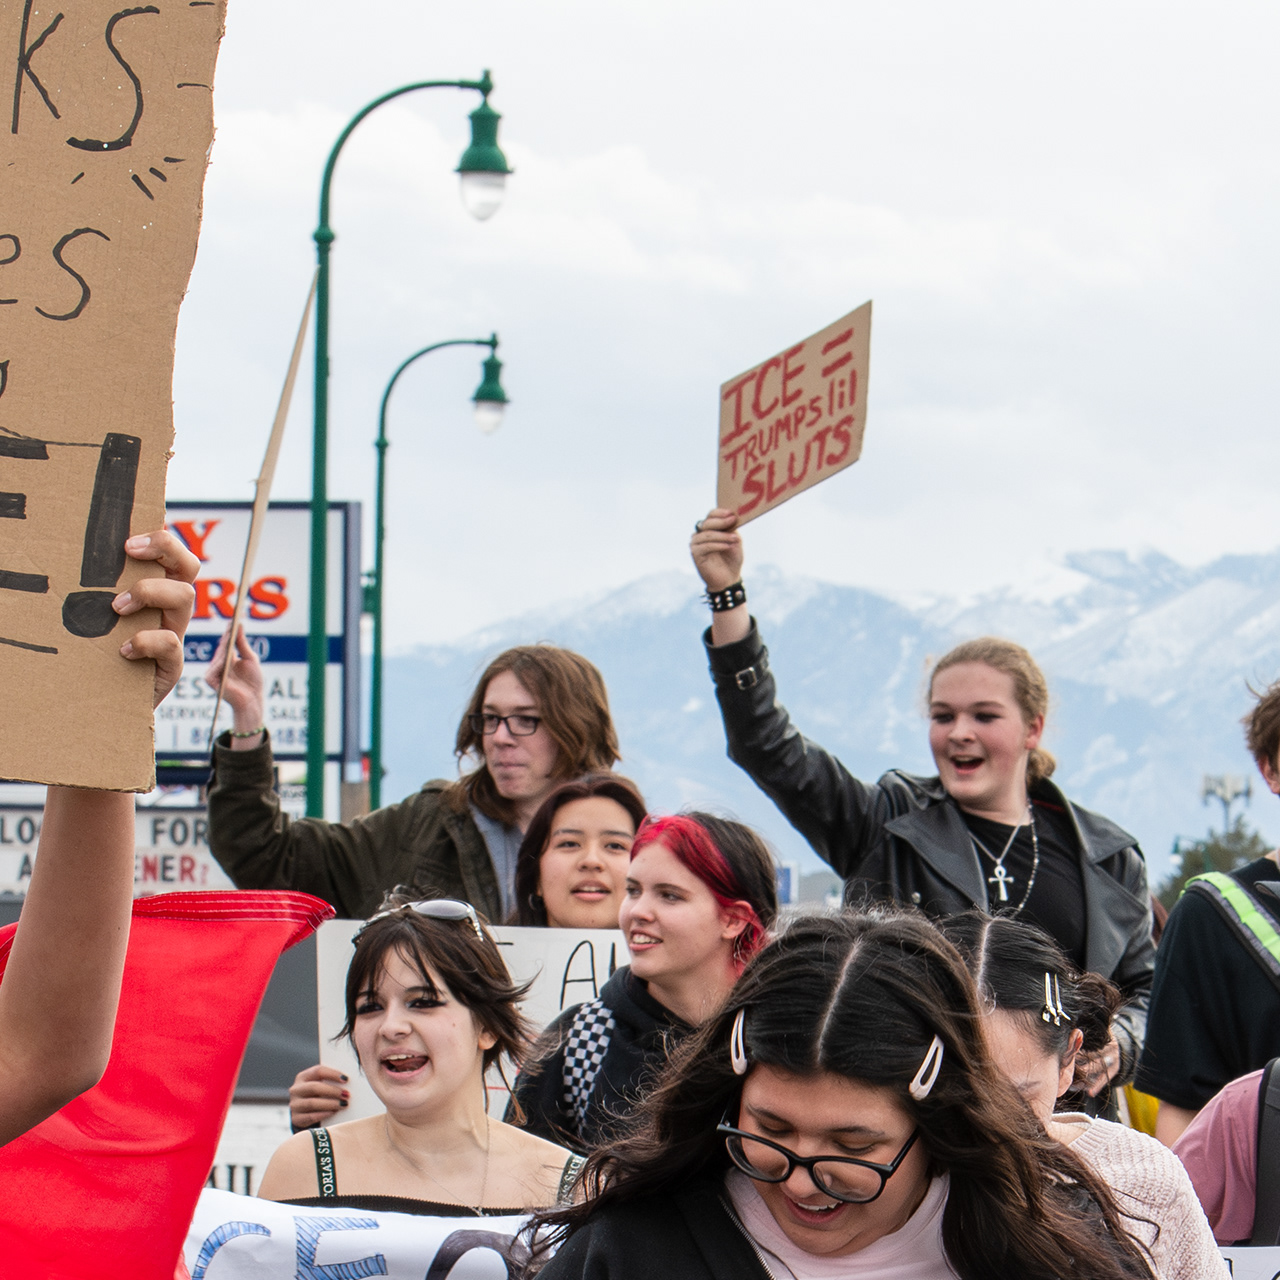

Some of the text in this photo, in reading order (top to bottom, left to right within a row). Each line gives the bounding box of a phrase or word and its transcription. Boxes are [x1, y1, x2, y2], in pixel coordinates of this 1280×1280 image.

[721, 343, 805, 447] ICE
[723, 396, 822, 480] TRUMPS
[737, 415, 854, 517] SLUTS
